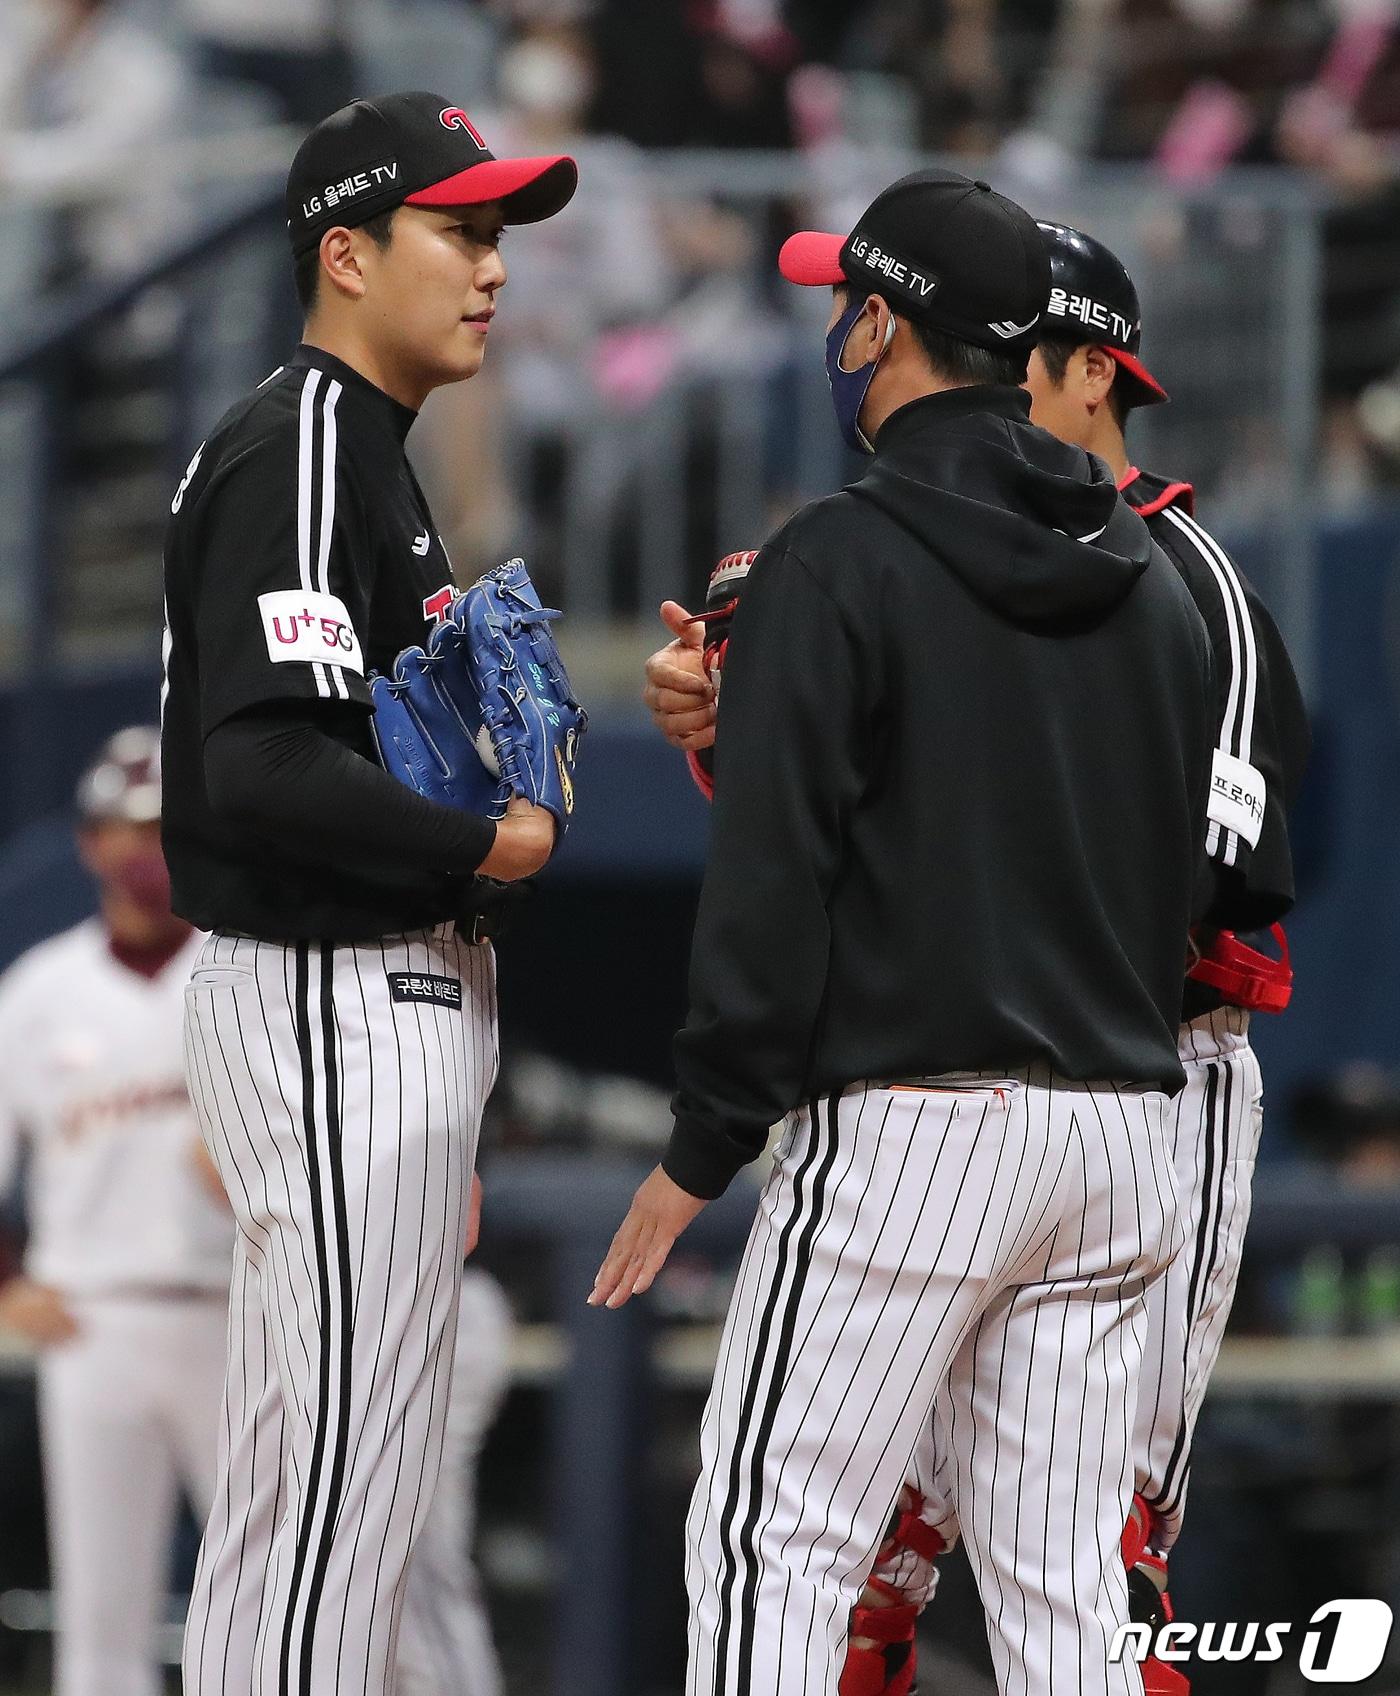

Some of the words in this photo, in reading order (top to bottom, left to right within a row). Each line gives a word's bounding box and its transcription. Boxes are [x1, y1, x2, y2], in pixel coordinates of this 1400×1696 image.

[303, 196, 321, 219] LG
[324, 172, 371, 208] 올레드
[371, 163, 398, 185] TV
[850, 236, 867, 258] LG
[866, 247, 907, 282] 올레드
[908, 272, 936, 297] TV
[1047, 287, 1109, 331] 올레드
[1109, 312, 1132, 344] TV
